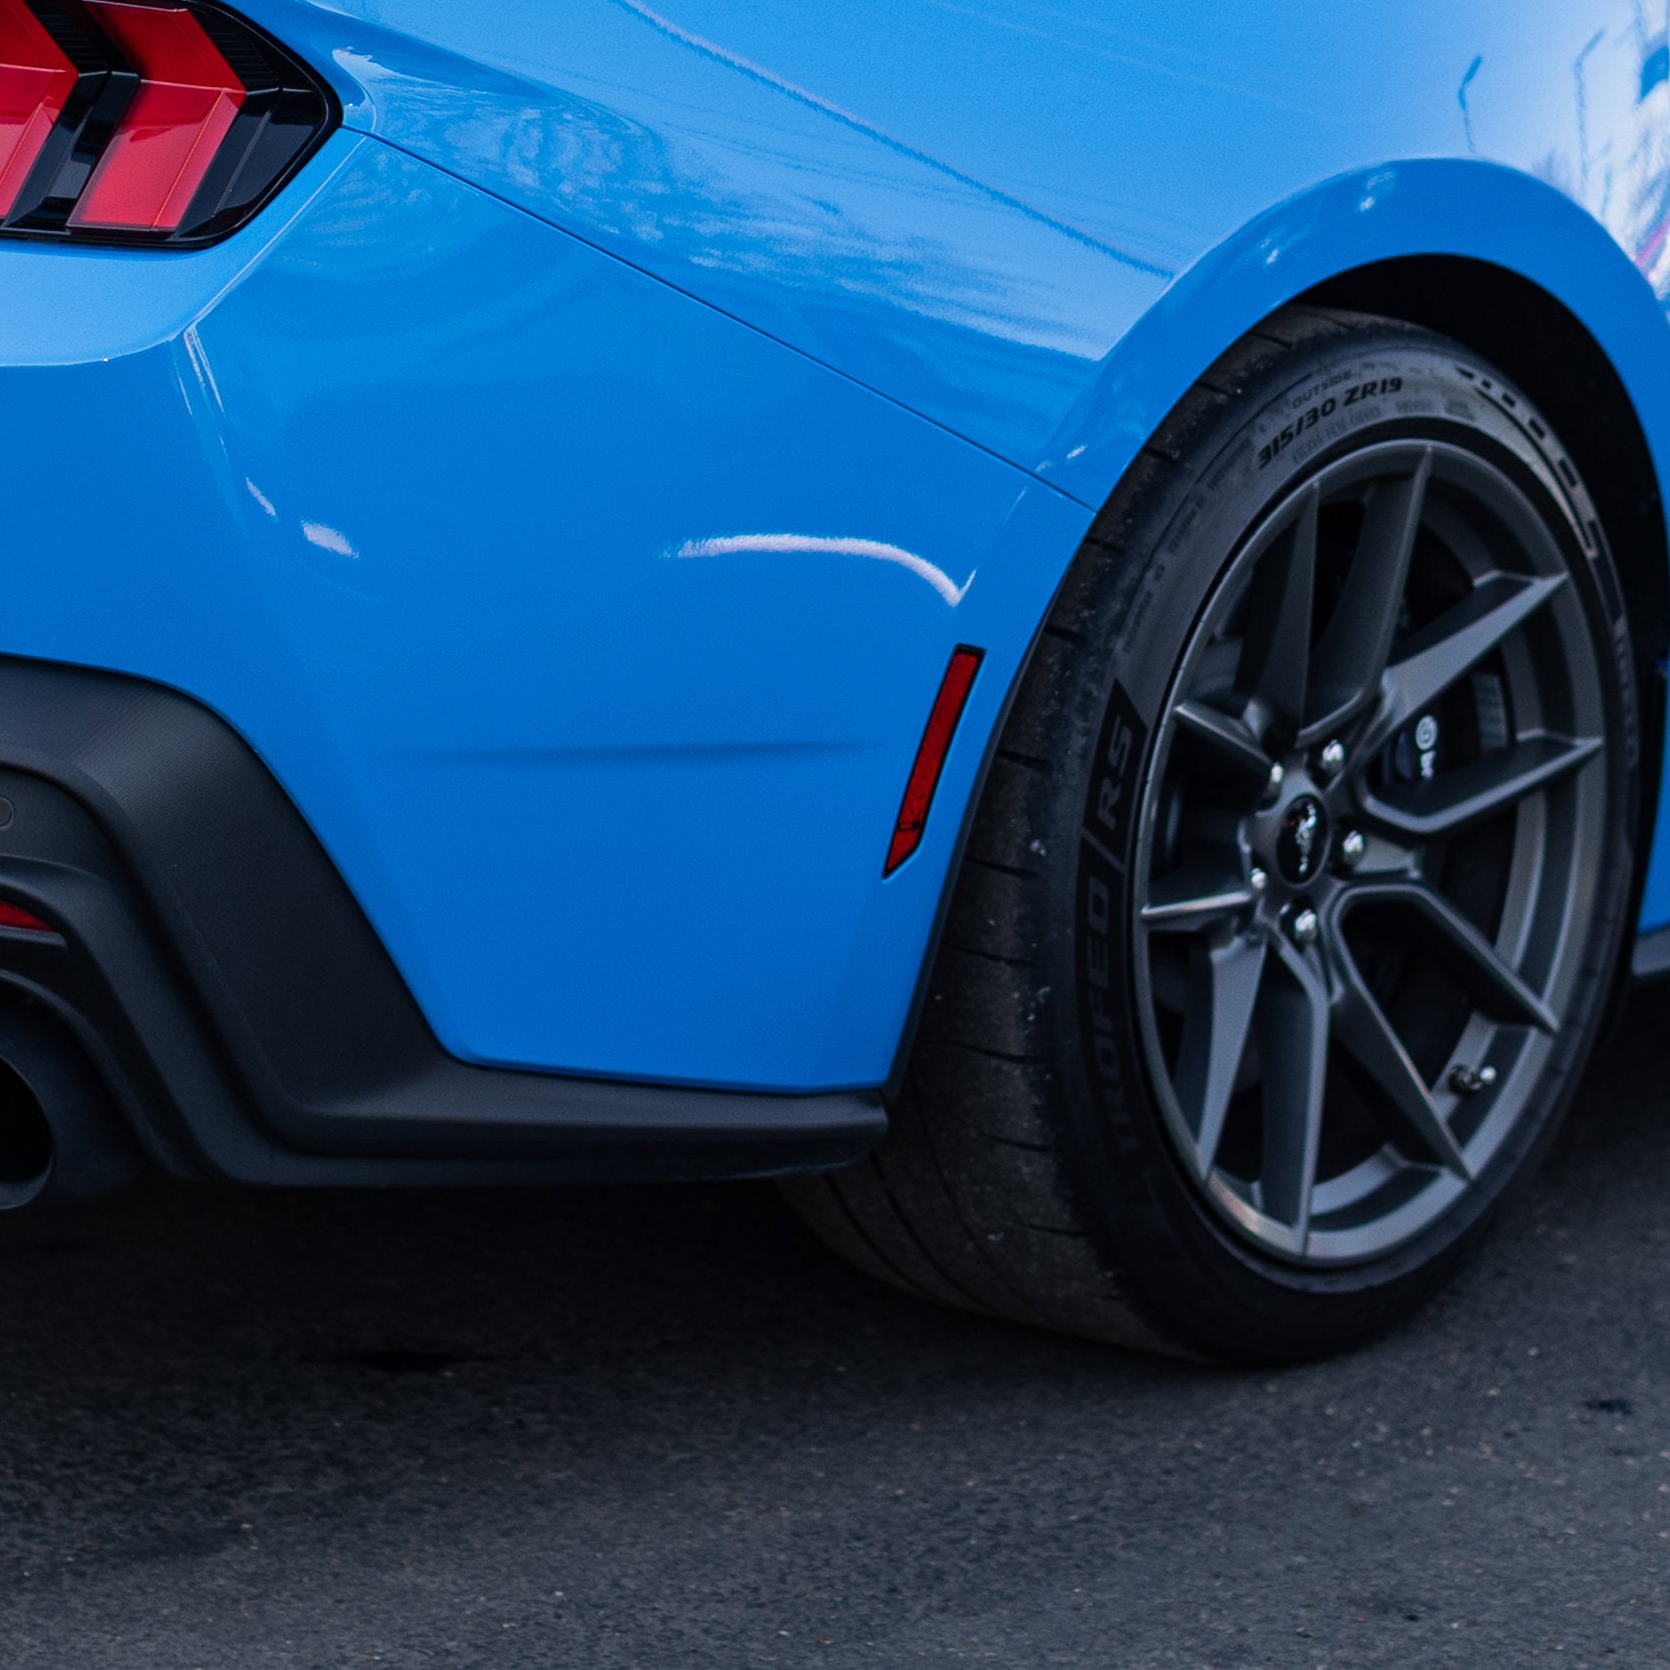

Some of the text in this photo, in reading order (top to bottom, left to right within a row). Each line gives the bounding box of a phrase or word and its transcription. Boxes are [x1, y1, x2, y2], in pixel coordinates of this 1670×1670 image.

[1258, 397, 1336, 470] 315/30
[1343, 377, 1403, 407] ZR19
[1086, 714, 1140, 1158] TROFEO RS
